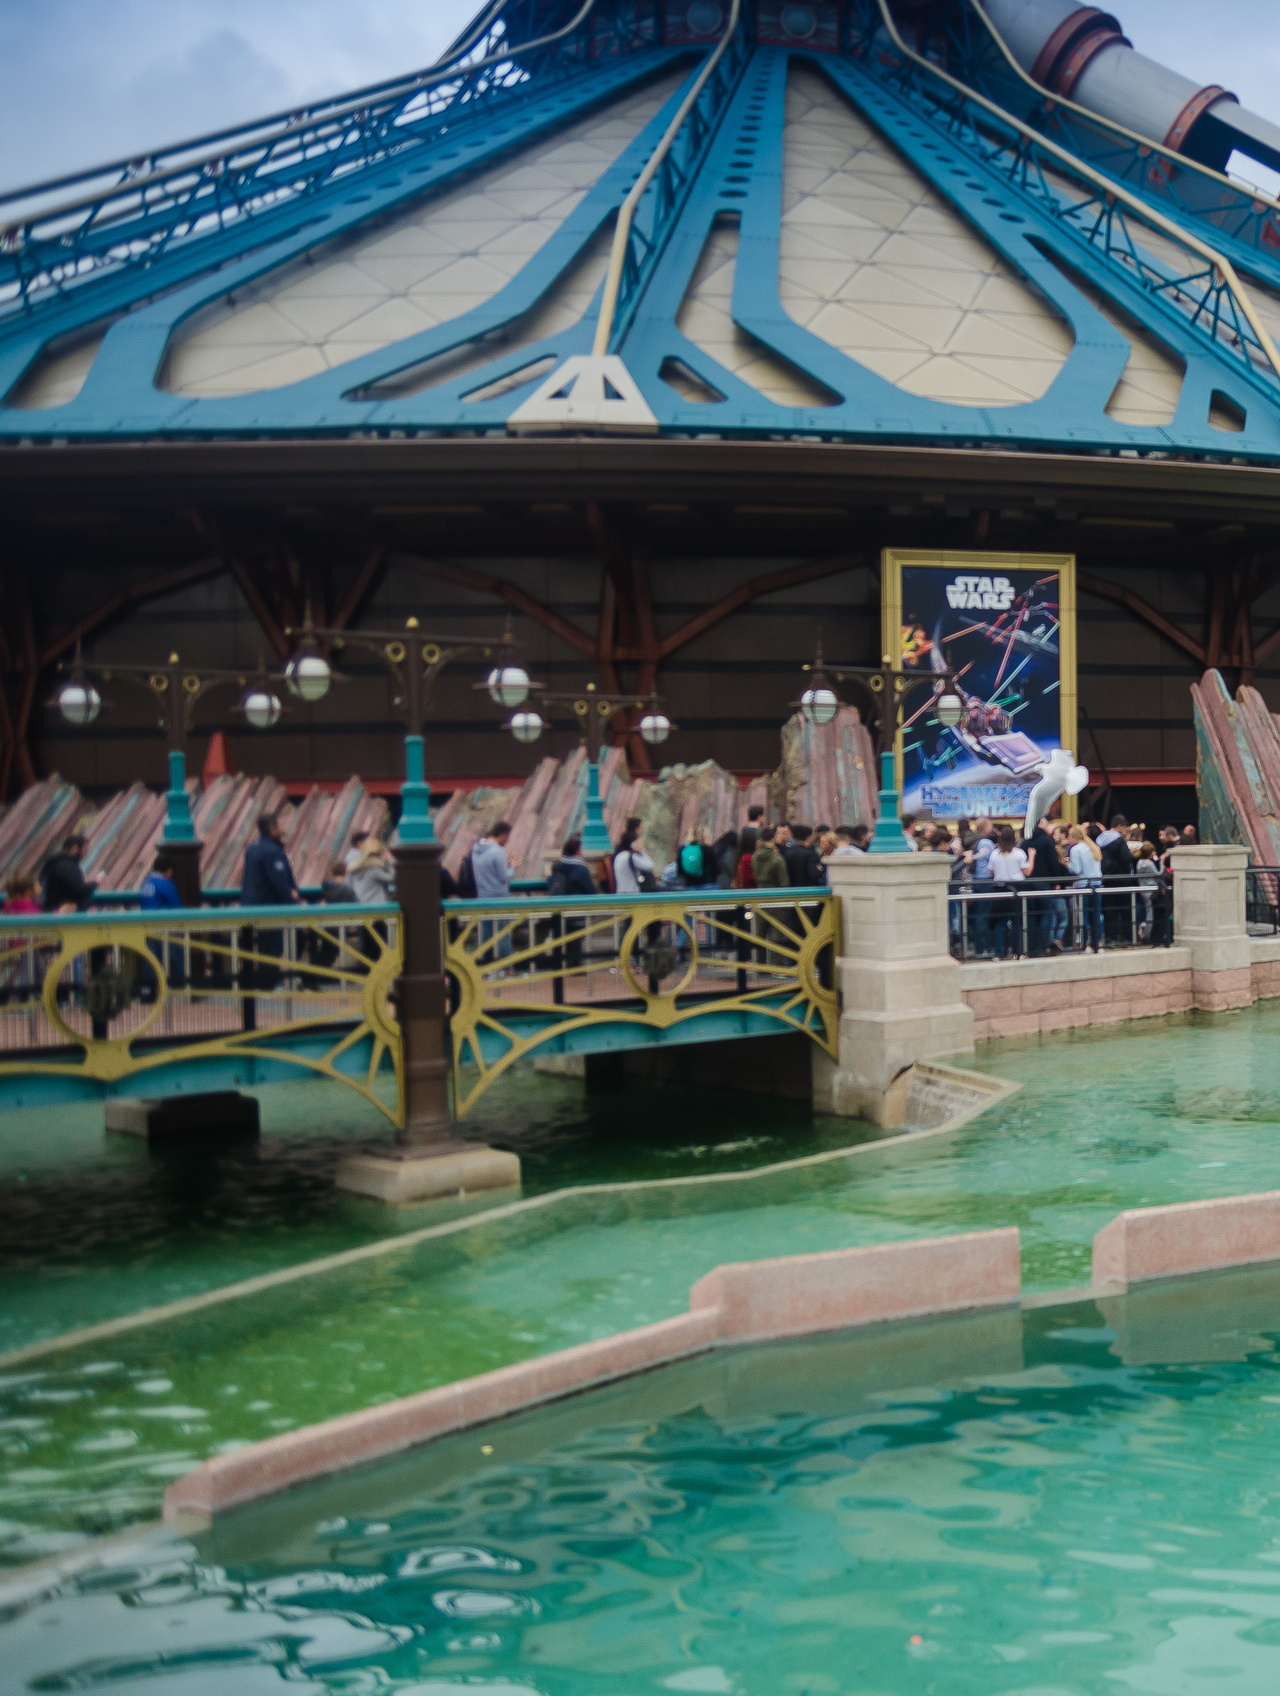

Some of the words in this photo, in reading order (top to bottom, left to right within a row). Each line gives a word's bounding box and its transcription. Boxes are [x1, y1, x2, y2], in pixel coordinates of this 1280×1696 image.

[946, 576, 1015, 593] STAR
[946, 591, 1015, 610] WARS
[921, 785, 1034, 800] HYPERSPAC
